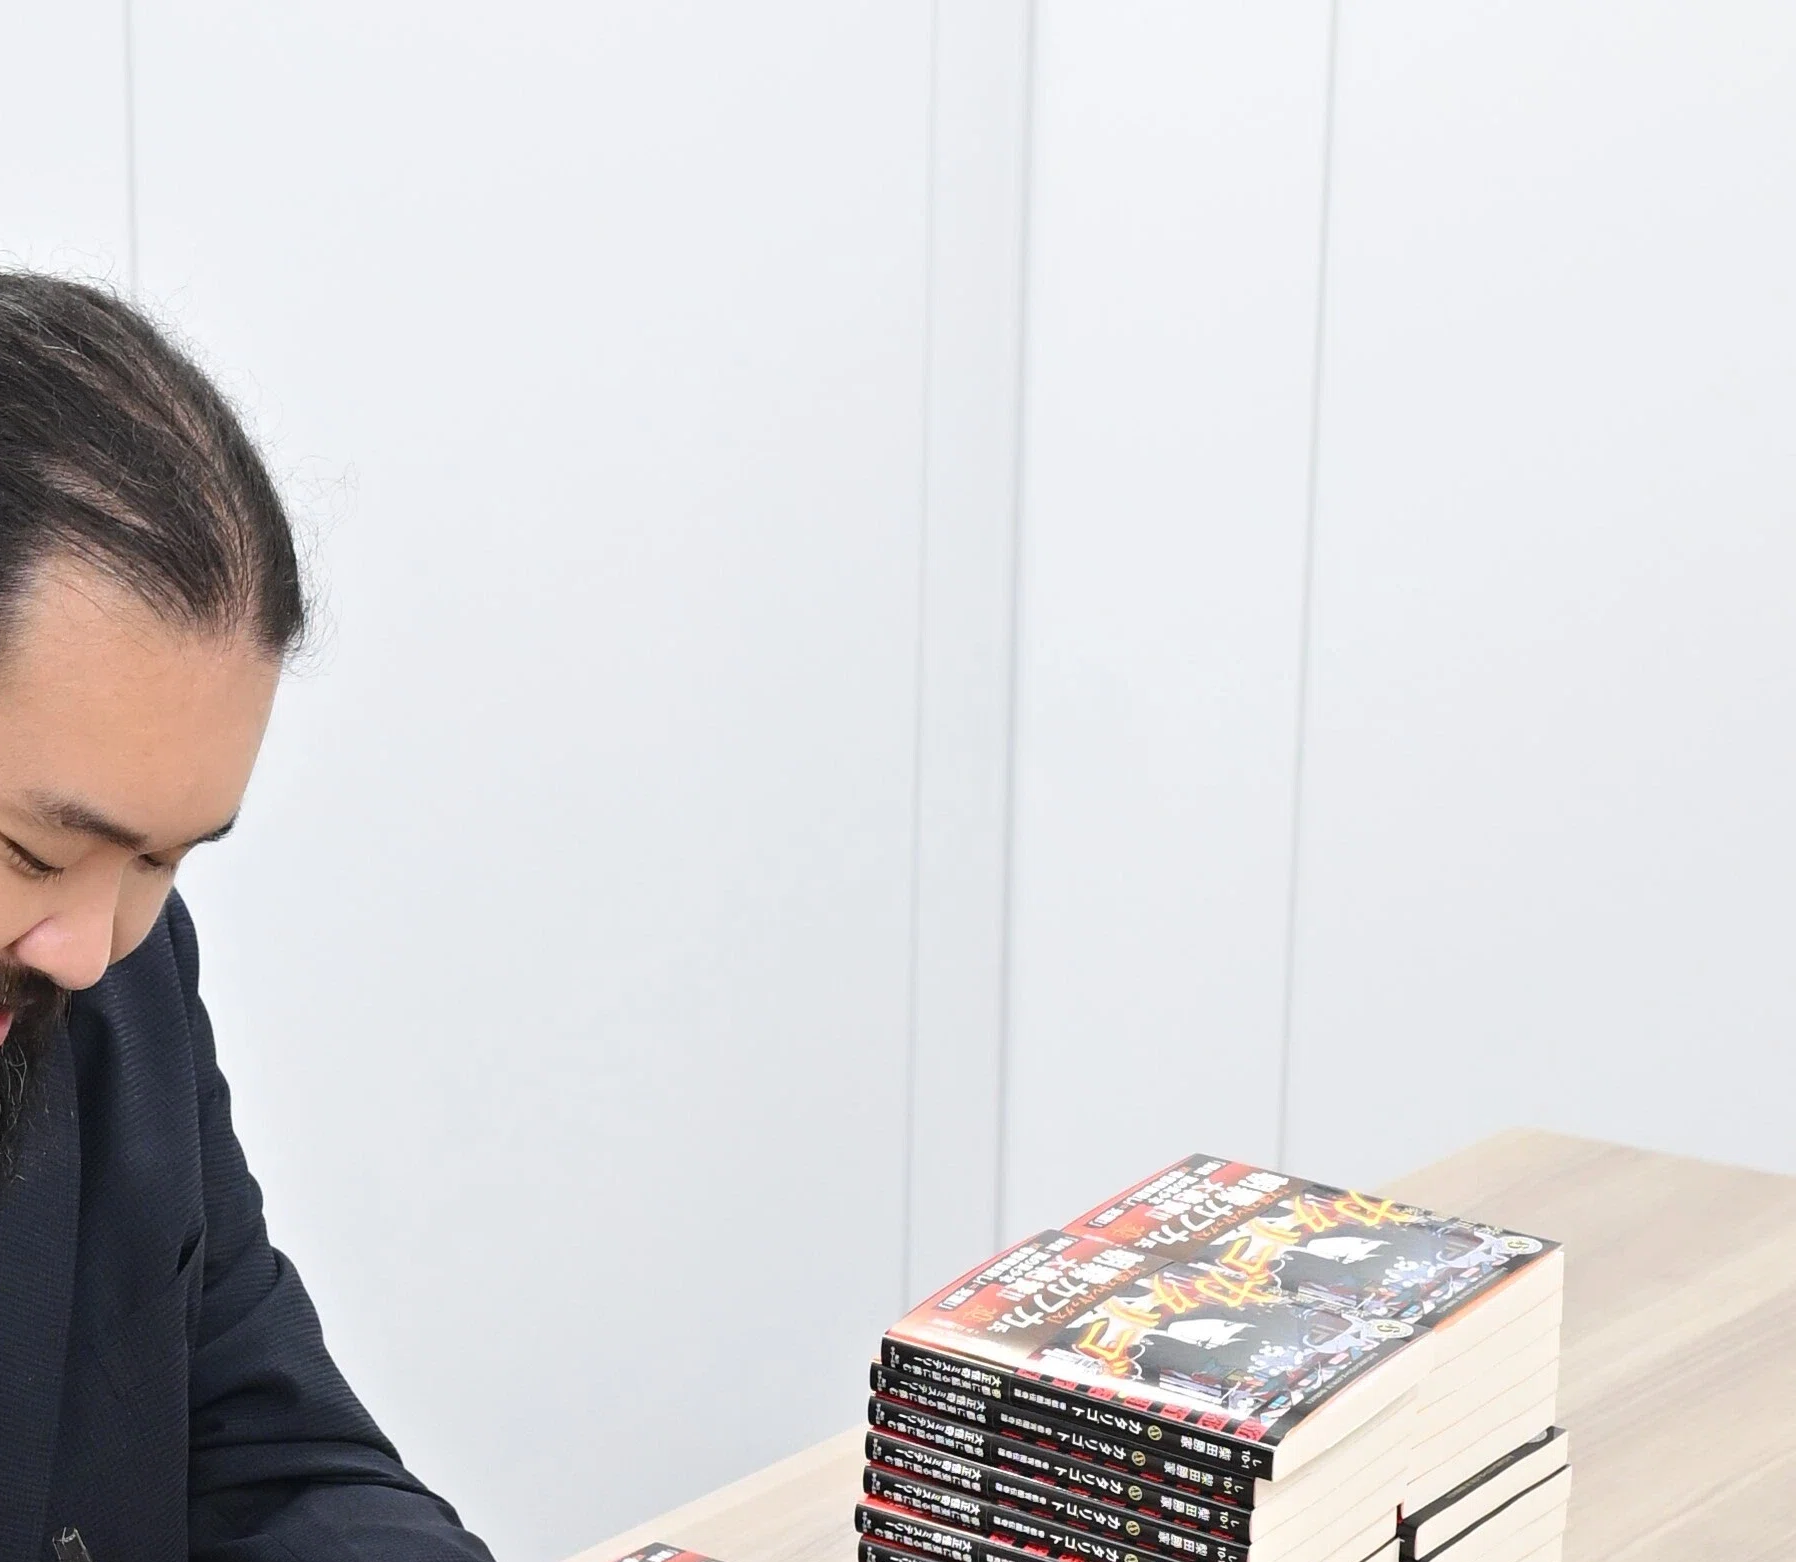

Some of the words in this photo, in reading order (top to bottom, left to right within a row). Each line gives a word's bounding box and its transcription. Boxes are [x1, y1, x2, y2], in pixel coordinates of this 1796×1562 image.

[1071, 1406, 1143, 1435] カタリゴト
[1057, 1432, 1127, 1460] カタリゴト
[1054, 1466, 1124, 1494] カタリゴト
[1051, 1501, 1121, 1530] カタリゴト
[1049, 1534, 1120, 1562] カタリゴト
